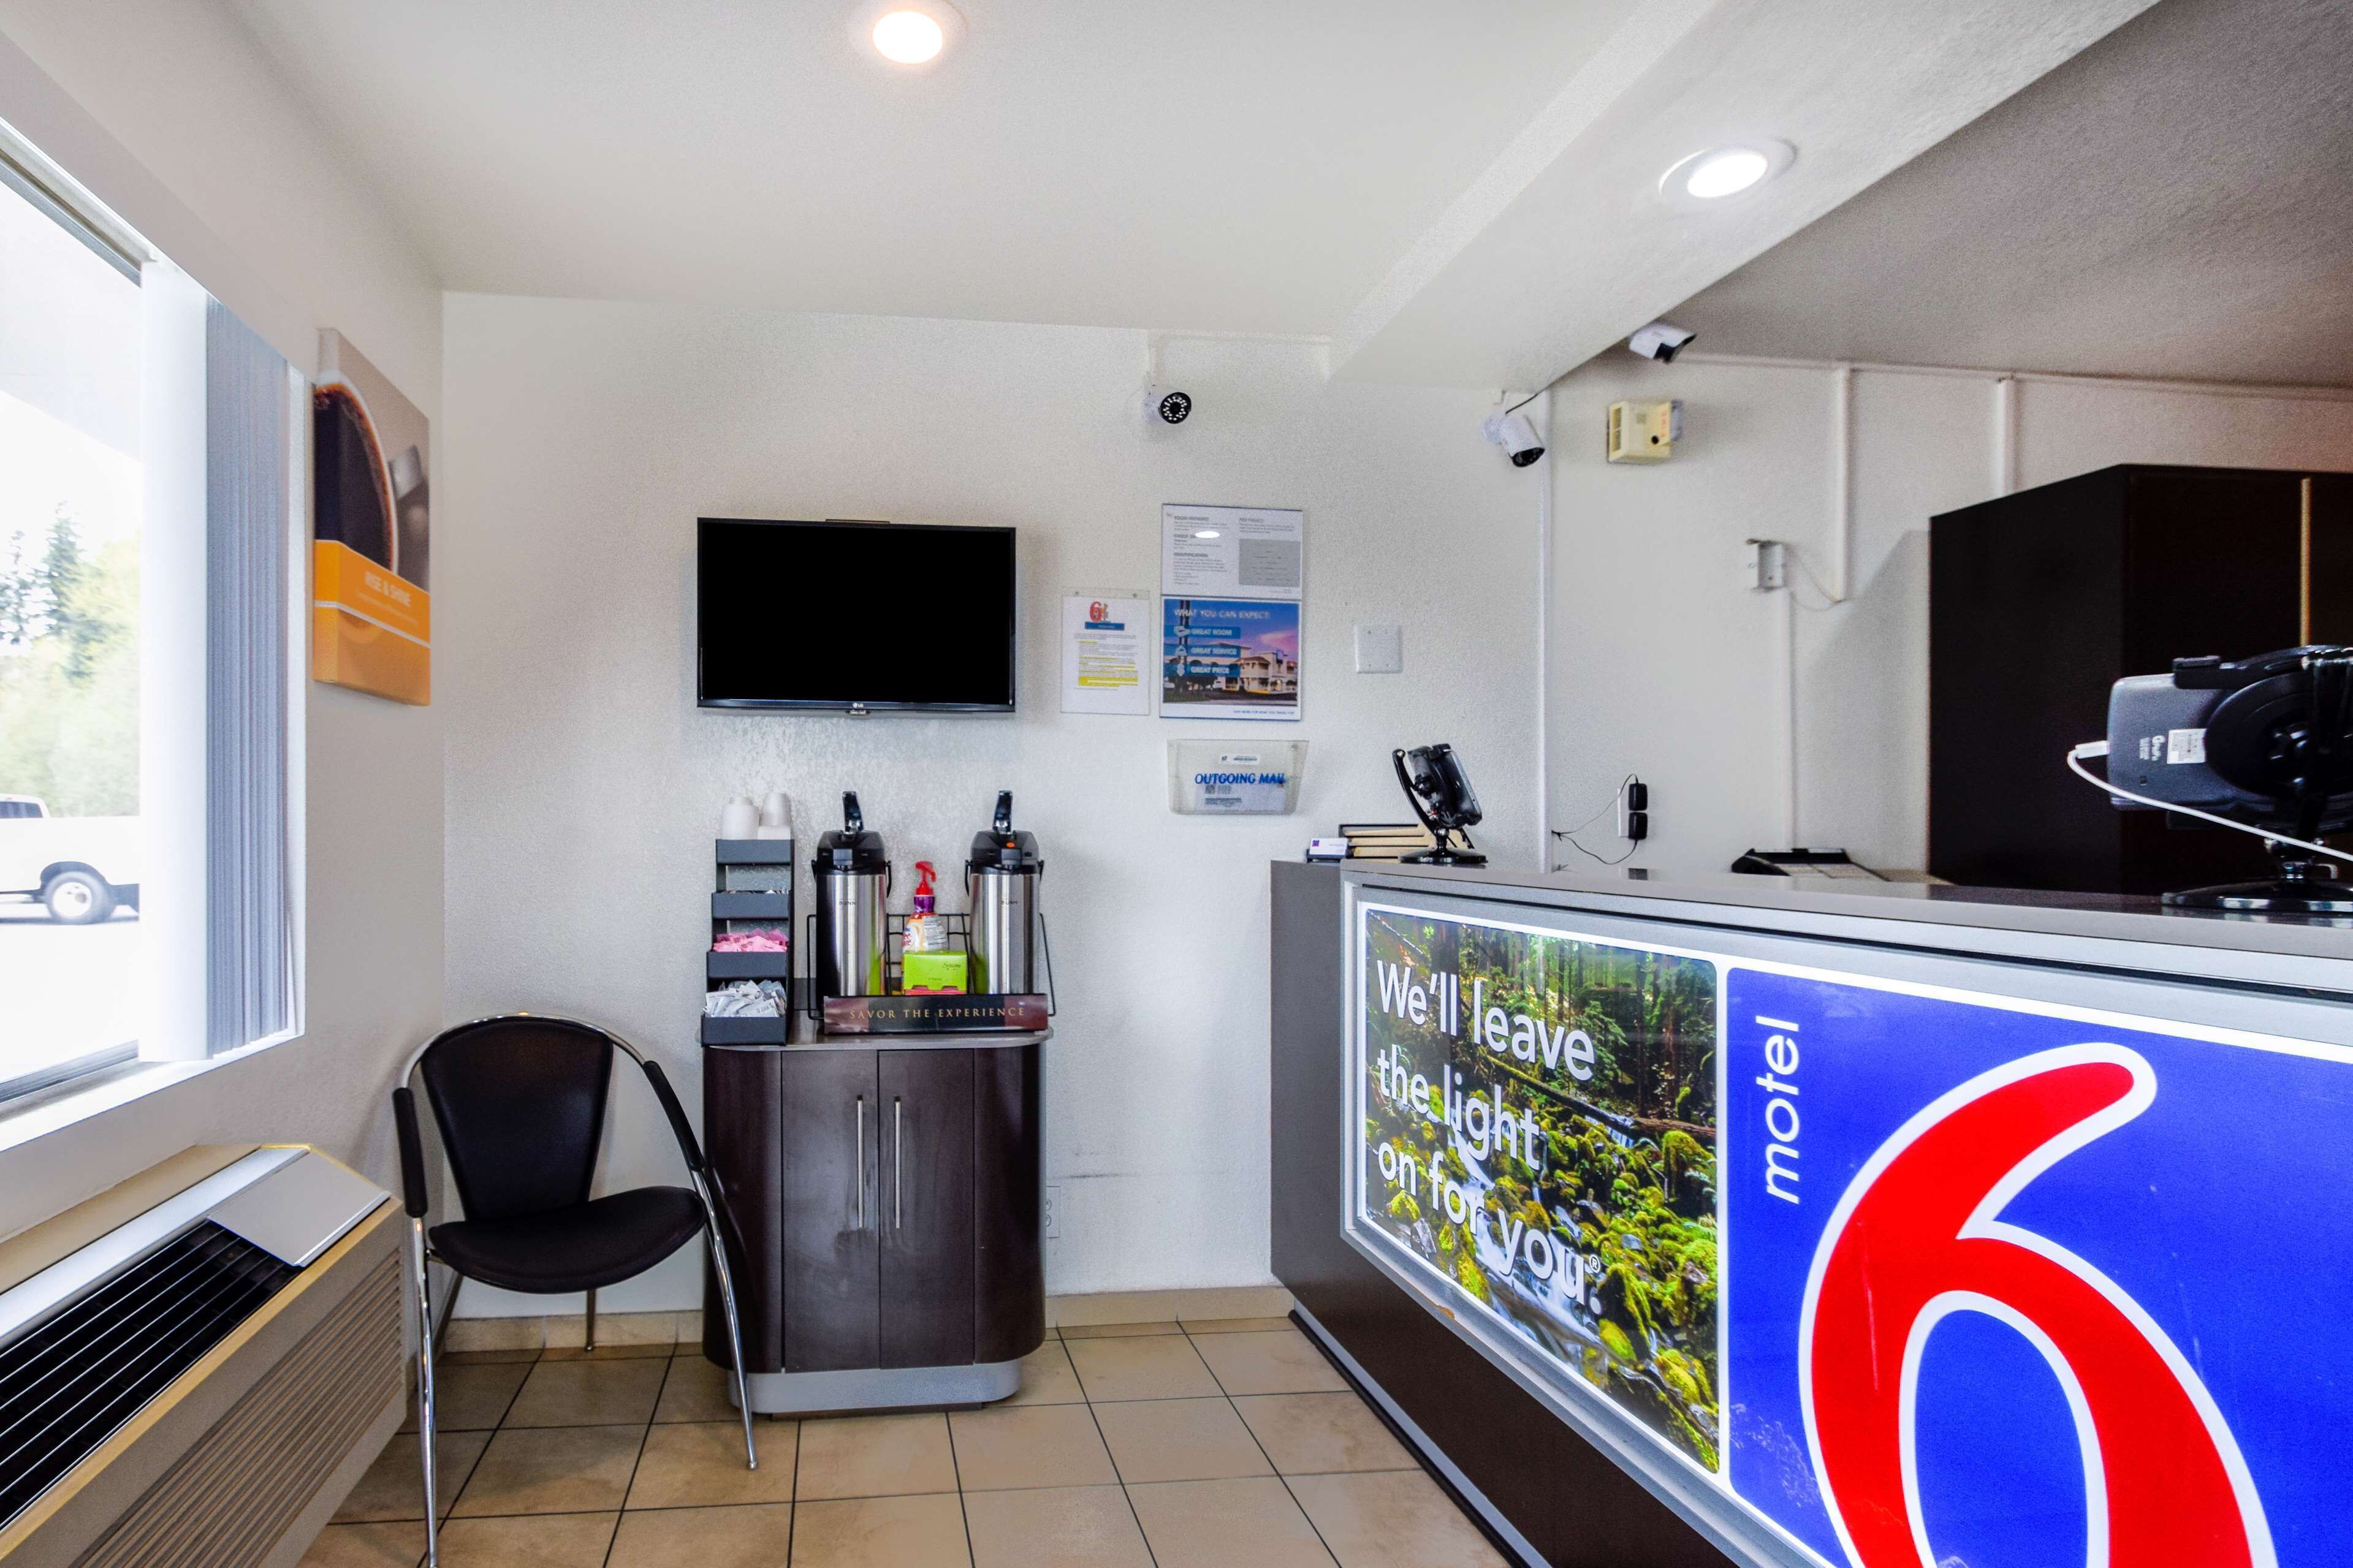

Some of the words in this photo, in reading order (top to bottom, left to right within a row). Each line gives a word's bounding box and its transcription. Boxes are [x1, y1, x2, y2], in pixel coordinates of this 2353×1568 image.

[1195, 773, 1256, 785] OUTGOING
[1258, 773, 1285, 784] MAIL
[850, 1010, 895, 1020] SAVOR
[903, 1009, 930, 1018] THE
[938, 1007, 1025, 1018] EXPERIENCE
[1474, 980, 1595, 1081] leave
[1377, 1044, 1429, 1114] the
[1444, 1064, 1540, 1170] light
[1755, 1015, 1800, 1205] motel
[1378, 1142, 1416, 1196] on
[1429, 1151, 1485, 1235] for
[1798, 1042, 2279, 1568] 6
